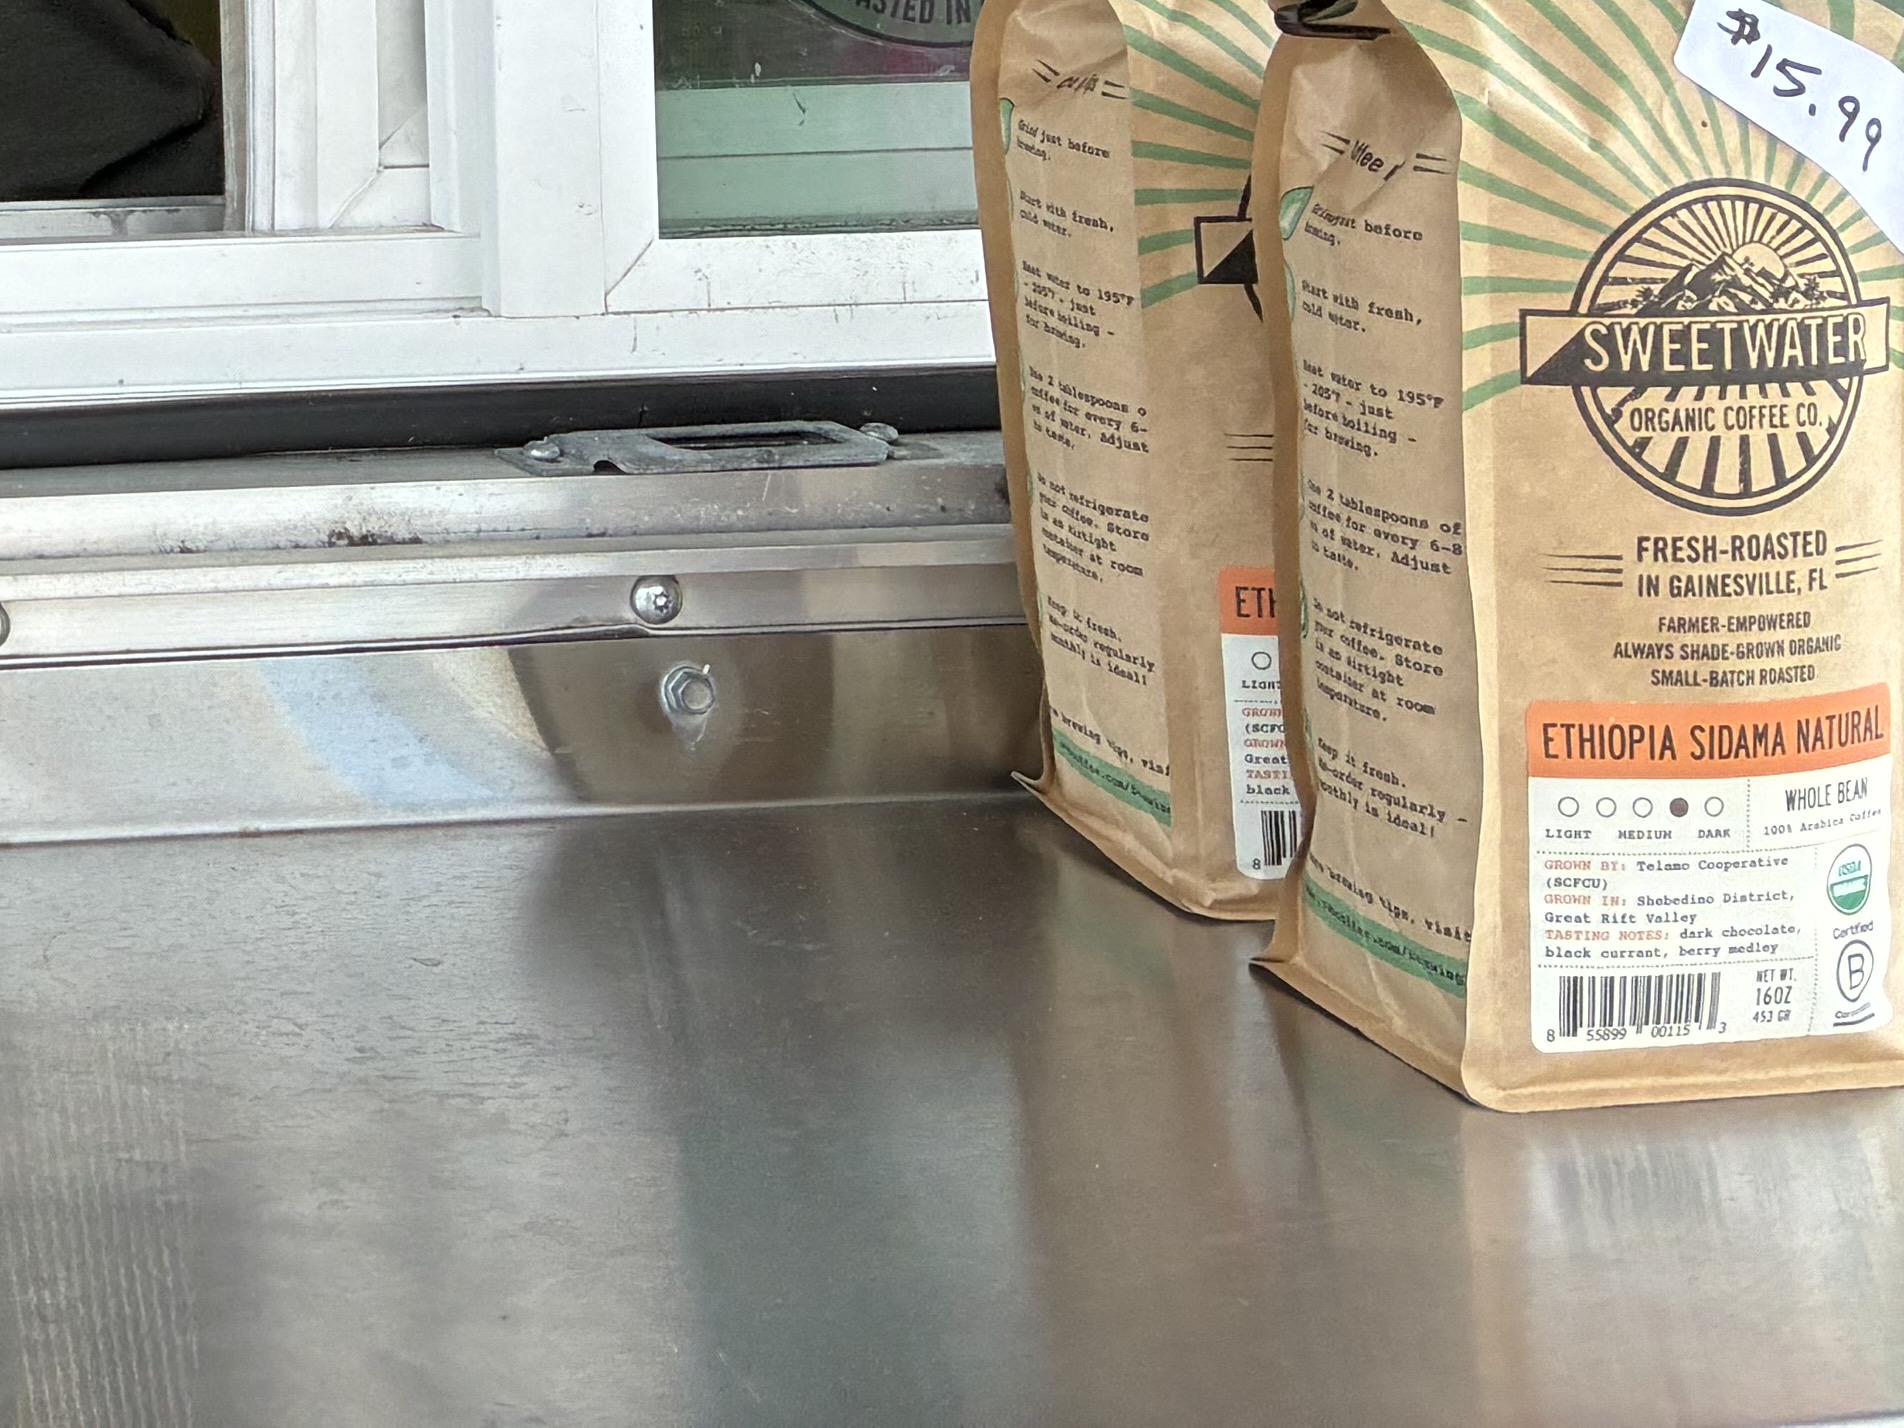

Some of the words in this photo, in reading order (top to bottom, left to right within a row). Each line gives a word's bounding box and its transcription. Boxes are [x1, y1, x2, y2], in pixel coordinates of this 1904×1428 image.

[1716, 7, 1883, 173] $15.99
[1364, 219, 1423, 242] before
[1367, 300, 1422, 326] fresh,
[1583, 313, 1868, 373] SWEETWATER
[1629, 407, 1716, 433] ORGANIC
[1723, 404, 1791, 431] COFFEE
[1796, 402, 1823, 428] CO.
[1339, 492, 1430, 530] tablespoons
[1636, 529, 1828, 563] FRESH-ROASTED
[1391, 550, 1452, 575] Adjust
[1638, 574, 1660, 597] IN
[1669, 570, 1802, 598] GAINESVILLE,
[1808, 567, 1828, 591] FL
[1658, 610, 1811, 633] FARMER-EMPOWERED
[1613, 642, 1674, 660] ALWAYS
[1679, 640, 1785, 660] SHADE-GROWN
[1788, 633, 1842, 656] ORGANIC
[1394, 653, 1444, 677] Store
[1650, 668, 1755, 688] SMALL-BATCH
[1759, 664, 1815, 684] ROASTED
[1542, 721, 1677, 761] ETHIOPIA
[1689, 721, 1786, 761] SIDAMA
[1796, 704, 1884, 754] NATURAL
[1244, 753, 1287, 766] Great
[1246, 784, 1291, 796] black
[1785, 784, 1832, 812] WHOLE
[1837, 777, 1869, 804] BEAN
[1545, 828, 1593, 839] LIGHT
[1617, 829, 1673, 840] MEDIUM
[1697, 828, 1731, 839] DARK
[1544, 859, 1592, 871] GROWN
[1601, 860, 1626, 871] BY:
[1698, 856, 1789, 872] Cooperative
[1545, 877, 1608, 891] (SCFCU)
[1544, 894, 1592, 906] GROWN
[1601, 895, 1626, 906] IN:
[1722, 891, 1794, 904] District,
[1544, 911, 1592, 924] Great
[1601, 913, 1637, 924] Rift
[1646, 912, 1698, 925] Valley
[1544, 929, 1610, 941] TASTING
[1618, 929, 1670, 941] NOTES:
[1679, 927, 1714, 940] dark
[1721, 924, 1802, 939] chocolate,
[1544, 946, 1592, 959] black
[1600, 948, 1668, 960] currant,
[1678, 946, 1721, 960] berry
[1728, 942, 1779, 957] medley
[1756, 969, 1776, 983] NET
[1752, 1011, 1773, 1023] 453
[1546, 1029, 1556, 1043] 8
[1586, 1027, 1627, 1042] 55899
[1650, 1023, 1691, 1039] 00115
[1718, 1021, 1727, 1034] 3
